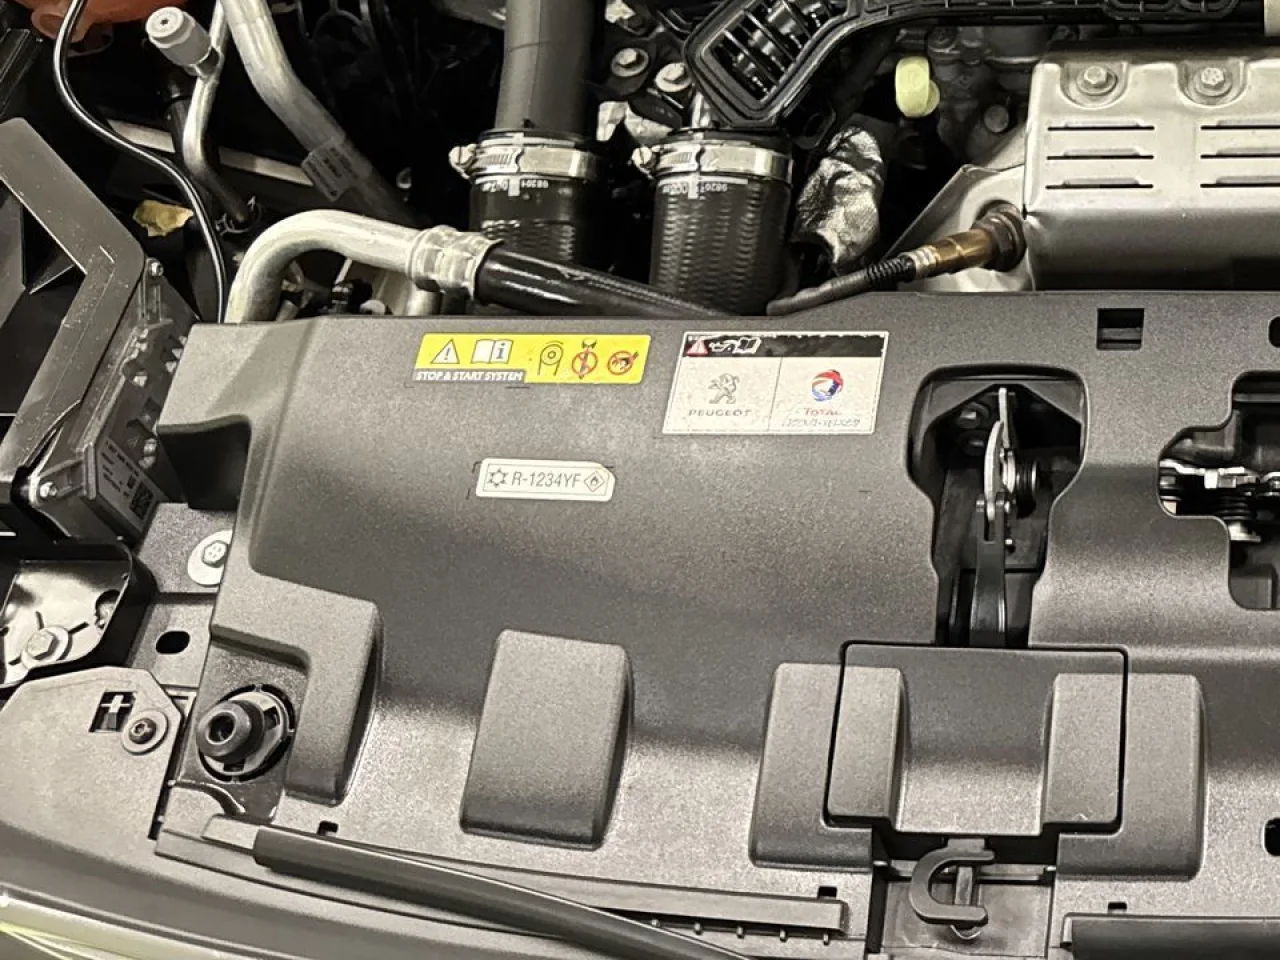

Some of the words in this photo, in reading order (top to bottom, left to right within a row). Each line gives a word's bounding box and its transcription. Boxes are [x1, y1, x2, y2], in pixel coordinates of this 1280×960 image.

[416, 371, 443, 380] STOP
[451, 371, 484, 380] START
[485, 371, 523, 380] SYSTEM
[688, 409, 752, 417] PEUGEOT
[803, 407, 842, 416] TOTAL
[511, 471, 582, 489] R-1234YF
